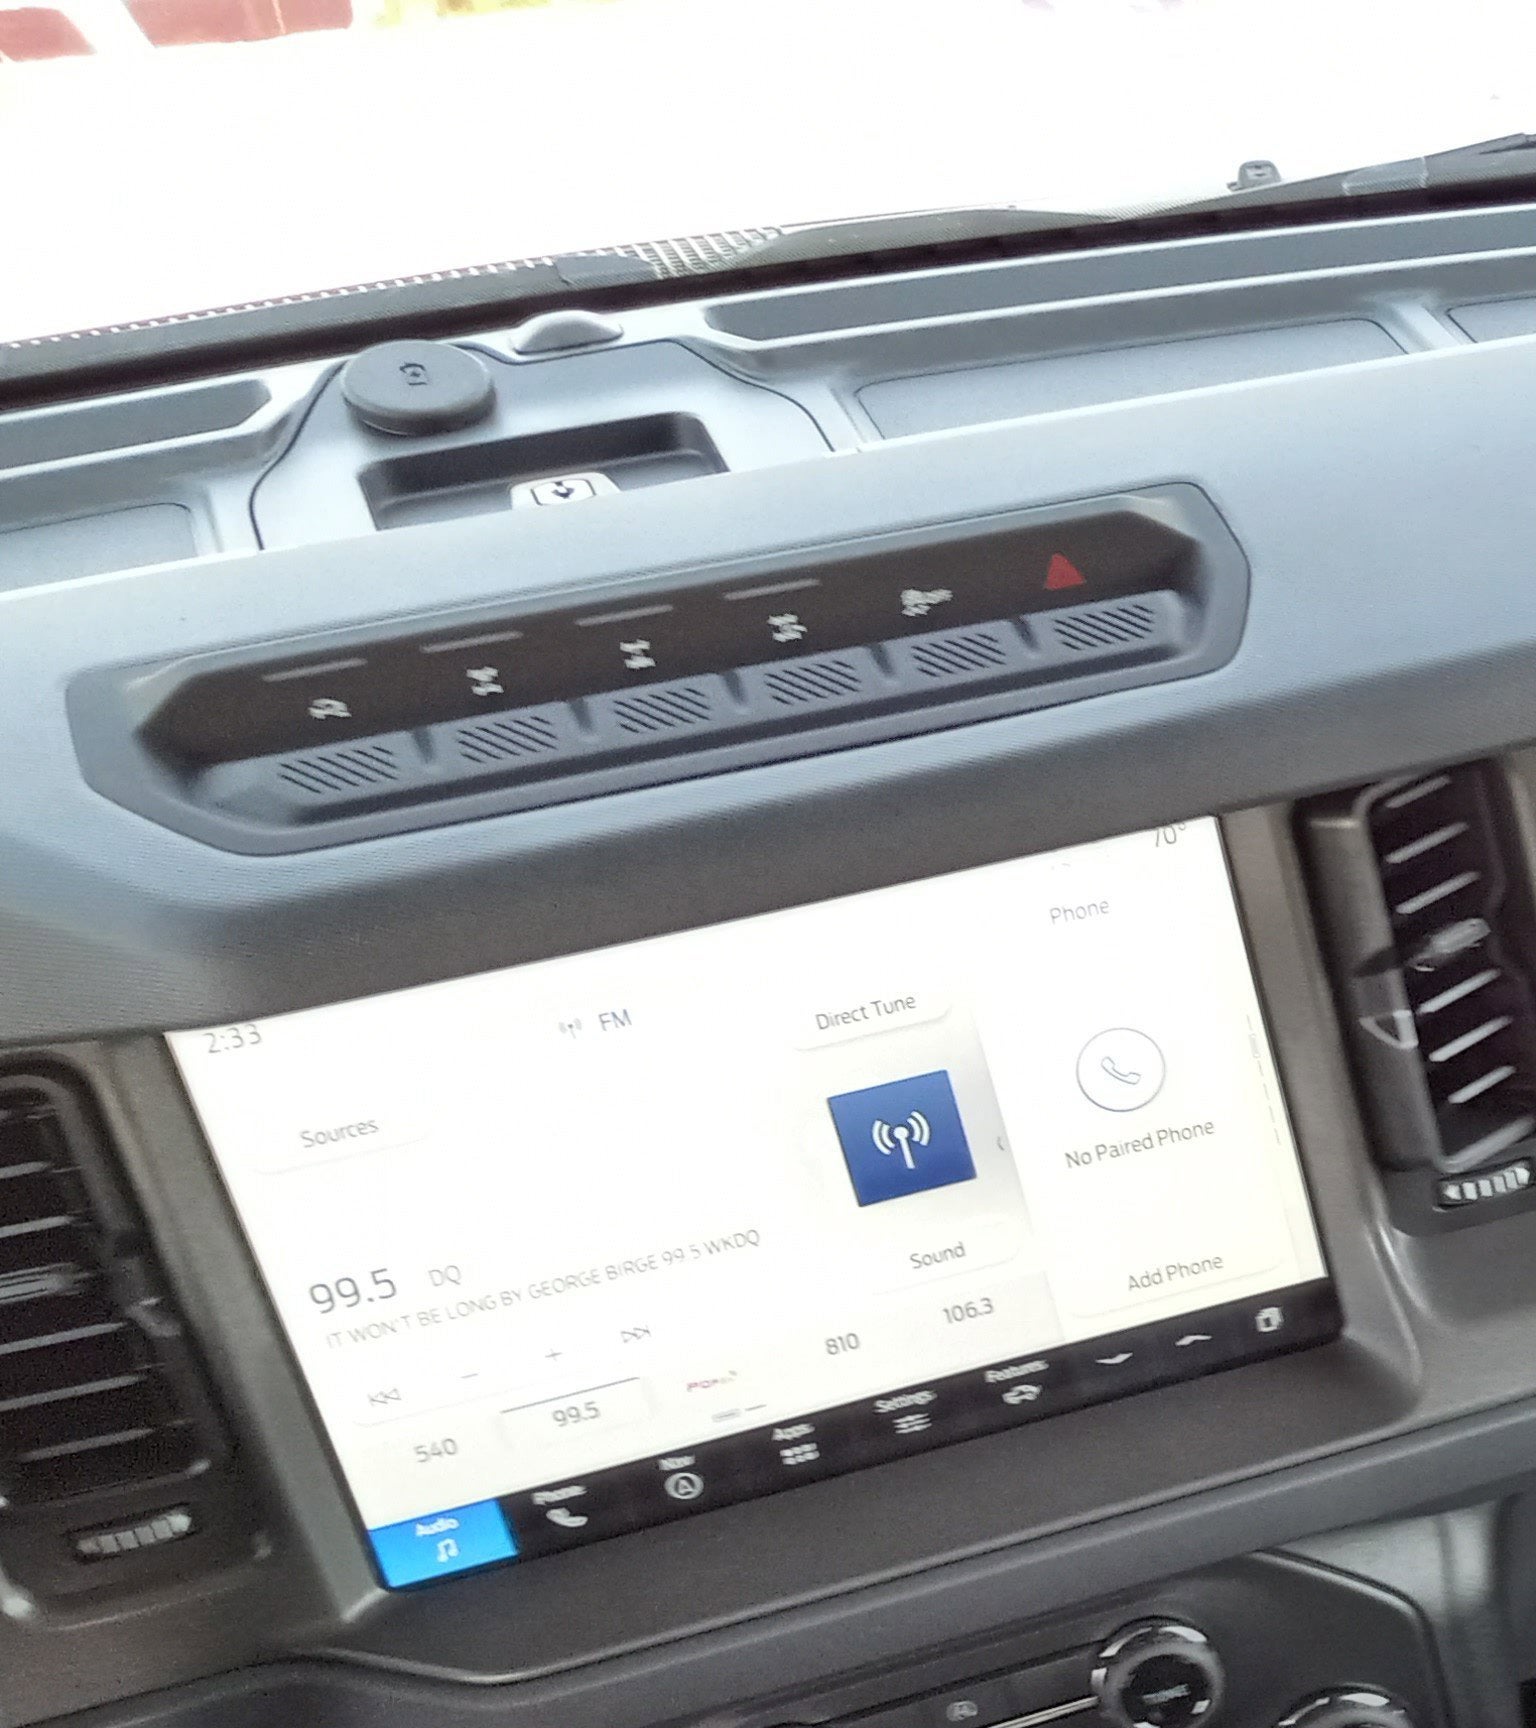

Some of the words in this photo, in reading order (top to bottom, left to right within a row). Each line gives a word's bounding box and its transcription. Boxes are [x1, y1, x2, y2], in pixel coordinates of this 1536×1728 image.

[1049, 897, 1111, 926] Phone
[598, 1008, 633, 1033] FM
[815, 1003, 868, 1032] Direct
[870, 992, 918, 1020] Tune
[206, 1023, 263, 1055] 2:33
[299, 1117, 381, 1148] Sources
[1065, 1148, 1093, 1170] No
[1096, 1133, 1154, 1165] Paired
[1157, 1118, 1216, 1150] Phone
[909, 1241, 967, 1271] Sound
[1127, 1270, 1164, 1293] Add
[1166, 1252, 1225, 1285] Phone
[308, 1266, 398, 1315] 99.5
[428, 1263, 463, 1290] DQ
[416, 1307, 442, 1328] BE
[446, 1292, 498, 1322] LONG
[500, 1287, 524, 1307] BY
[528, 1268, 602, 1300] GEORGE
[605, 1254, 659, 1282] BIRGE
[942, 1296, 995, 1326] 106.3
[823, 1331, 861, 1356] 810
[552, 1400, 602, 1428] 99.5
[875, 1387, 938, 1417] Settings
[771, 1421, 815, 1443] Apps
[413, 1436, 460, 1464] 540
[532, 1483, 588, 1506] Phone
[415, 1514, 459, 1538] Audio
